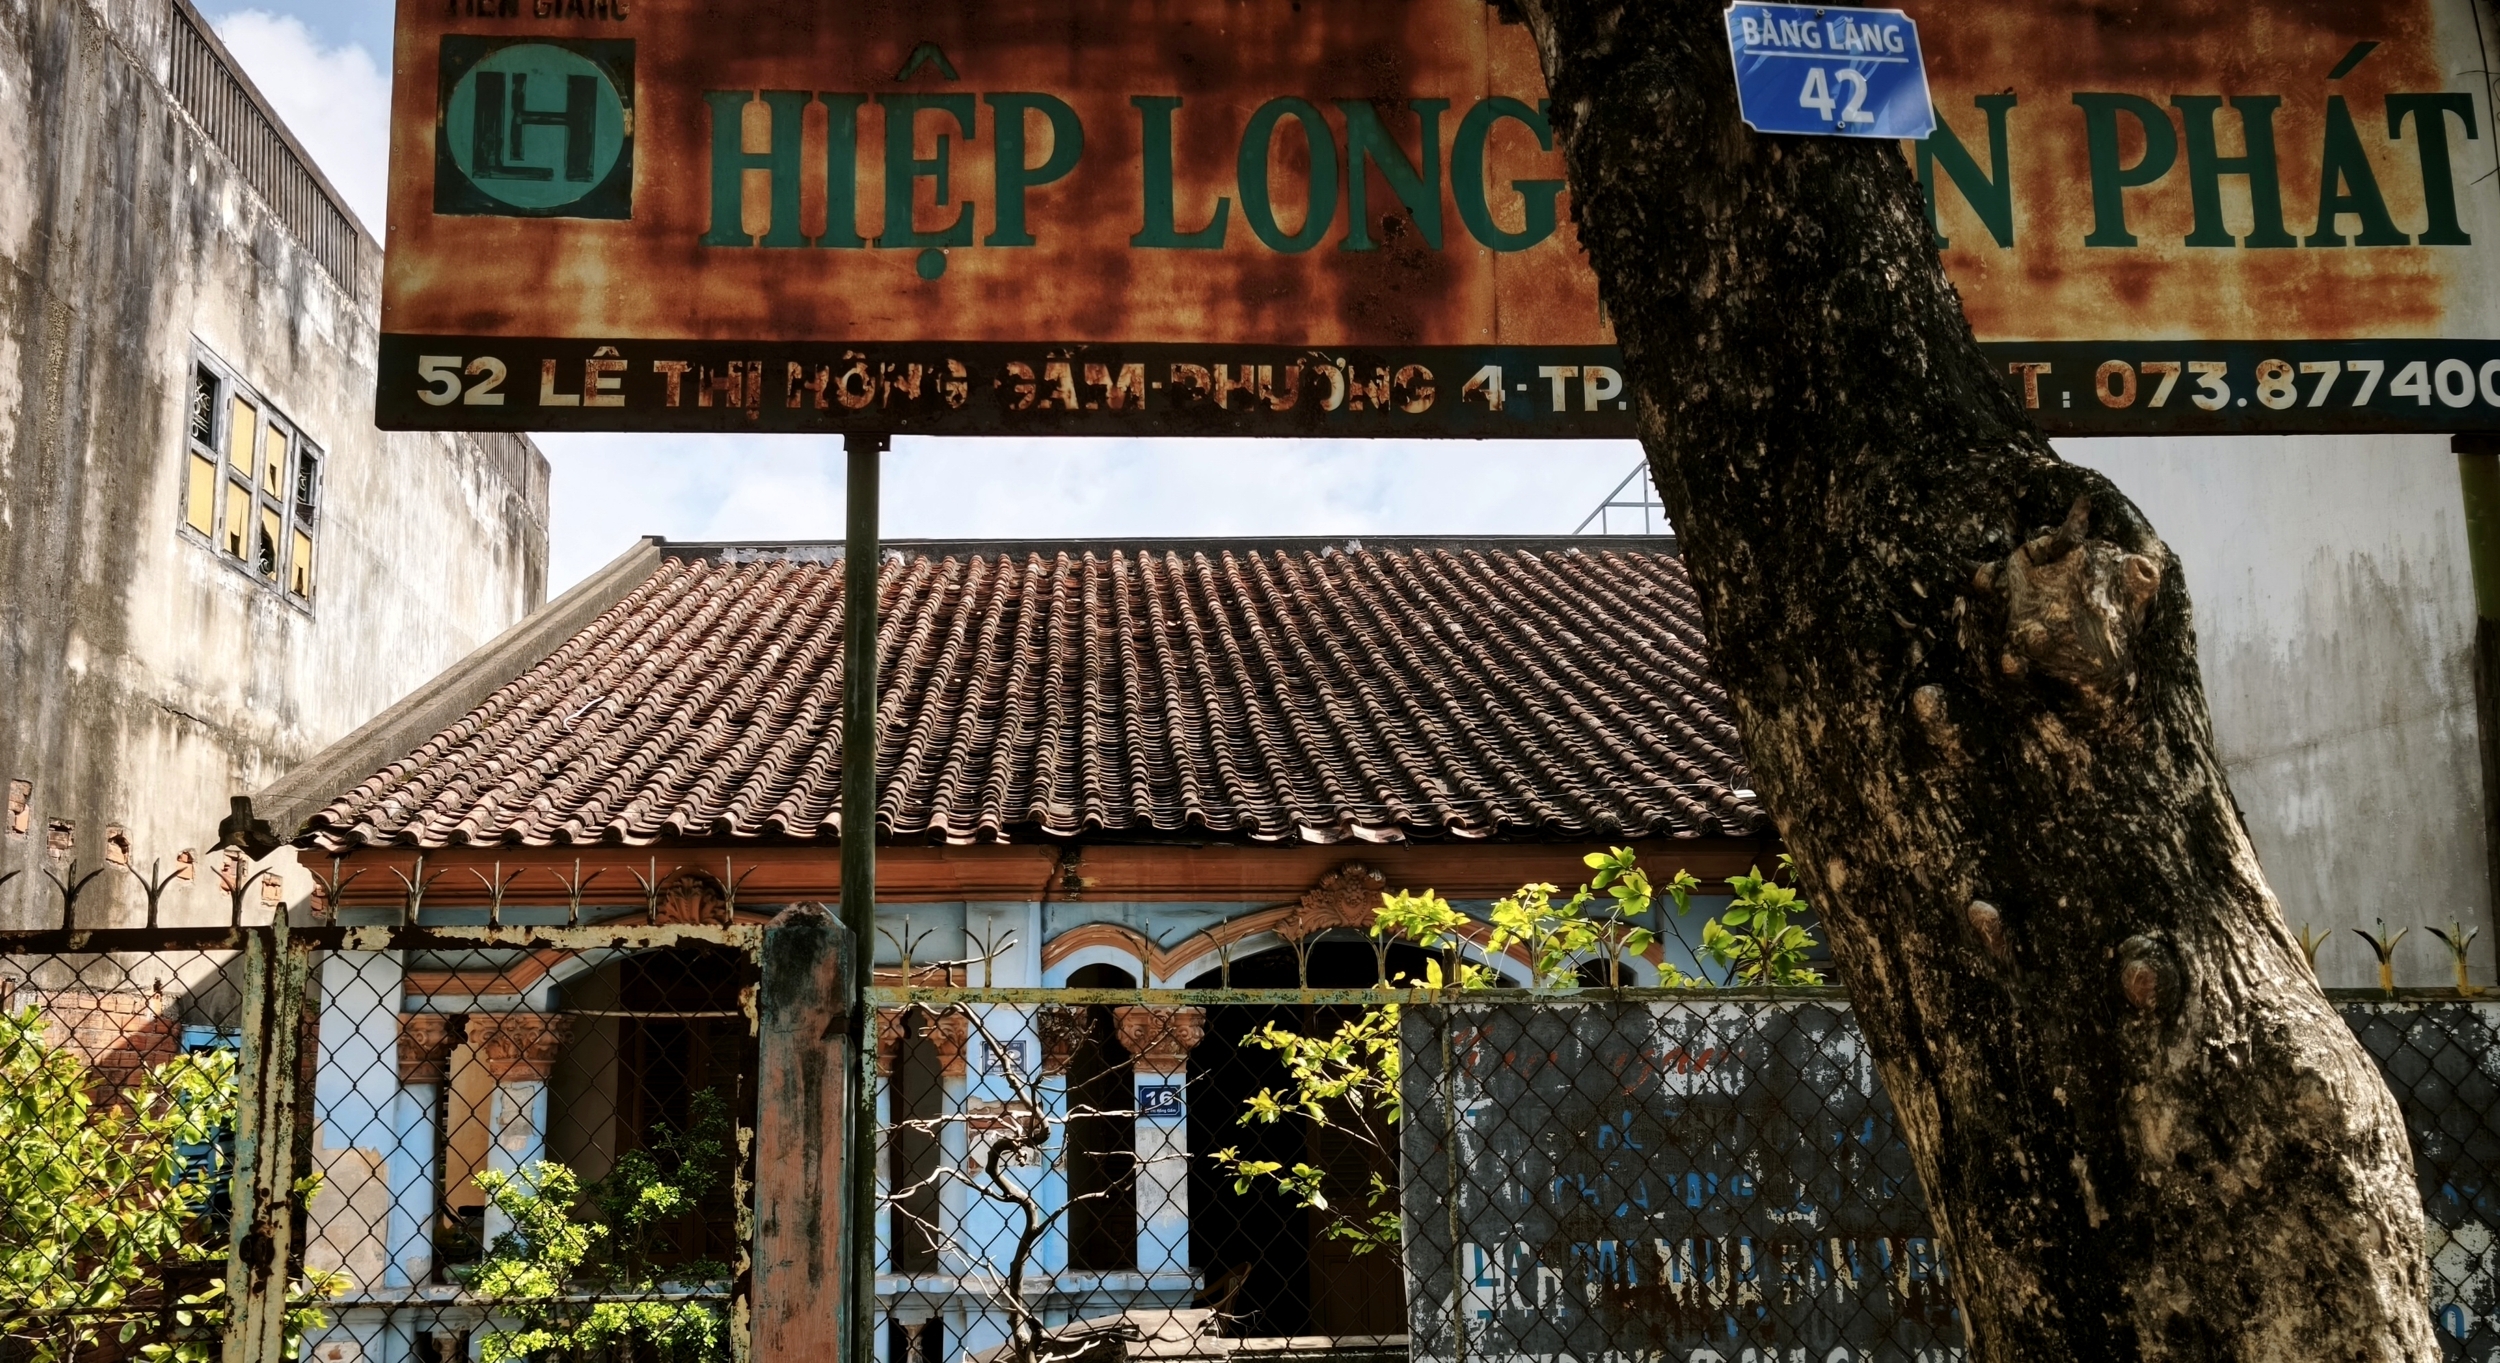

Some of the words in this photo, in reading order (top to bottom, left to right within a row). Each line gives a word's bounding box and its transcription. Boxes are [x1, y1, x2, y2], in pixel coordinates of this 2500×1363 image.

[1741, 9, 1822, 49] BẰNG
[1826, 17, 1904, 53] LĂNG
[1799, 67, 1875, 123] 42
[700, 42, 1085, 280] HIỆP
[1130, 95, 1566, 254] LONG
[2072, 41, 2479, 249] PHÁT
[417, 355, 507, 406] 52
[539, 346, 628, 407] LÊ
[653, 360, 762, 420] THỊ
[1462, 365, 1506, 411] 4
[1539, 366, 1627, 411] TP.
[1145, 1090, 1174, 1106] 16
